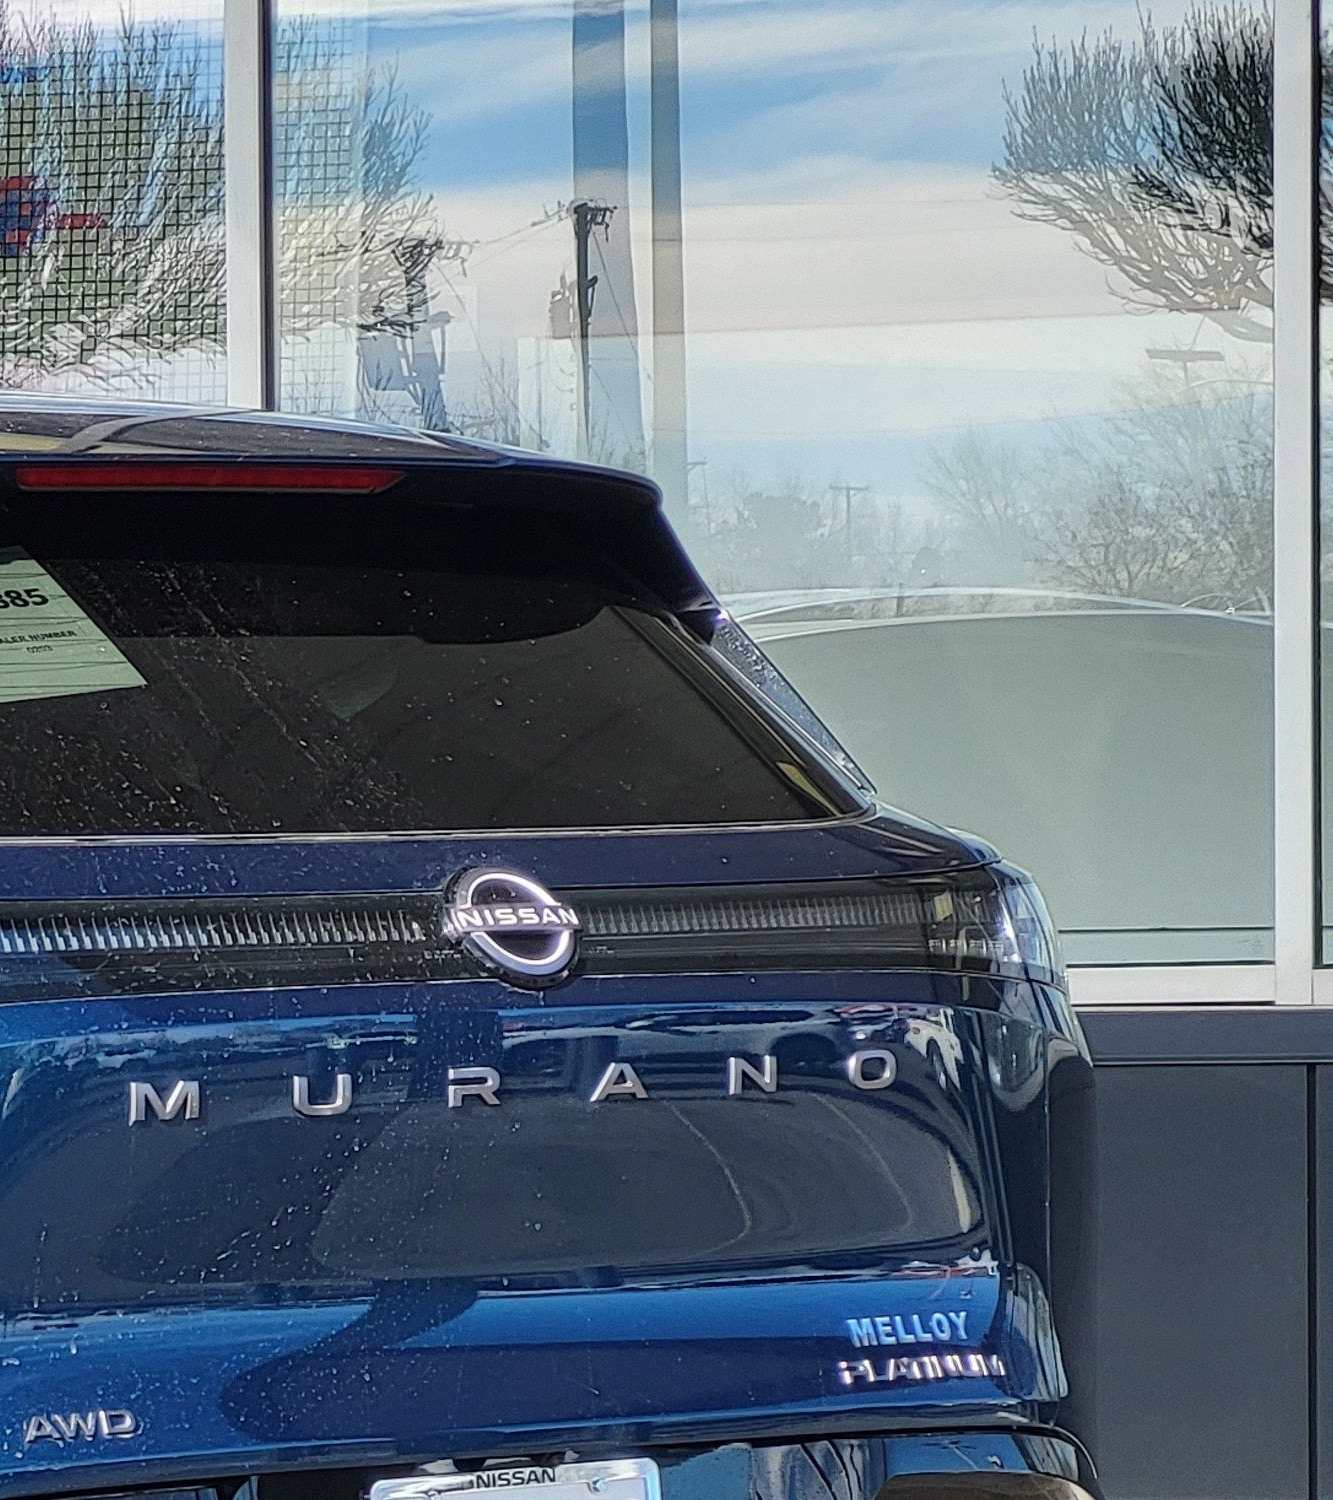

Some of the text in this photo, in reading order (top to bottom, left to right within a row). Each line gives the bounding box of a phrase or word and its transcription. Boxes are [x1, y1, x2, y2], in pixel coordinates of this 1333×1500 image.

[456, 903, 580, 929] NISSAN
[129, 1049, 898, 1124] MURANO
[845, 1310, 969, 1348] MELLOY
[24, 1409, 137, 1443] AWD
[474, 1466, 557, 1489] NISSAN
